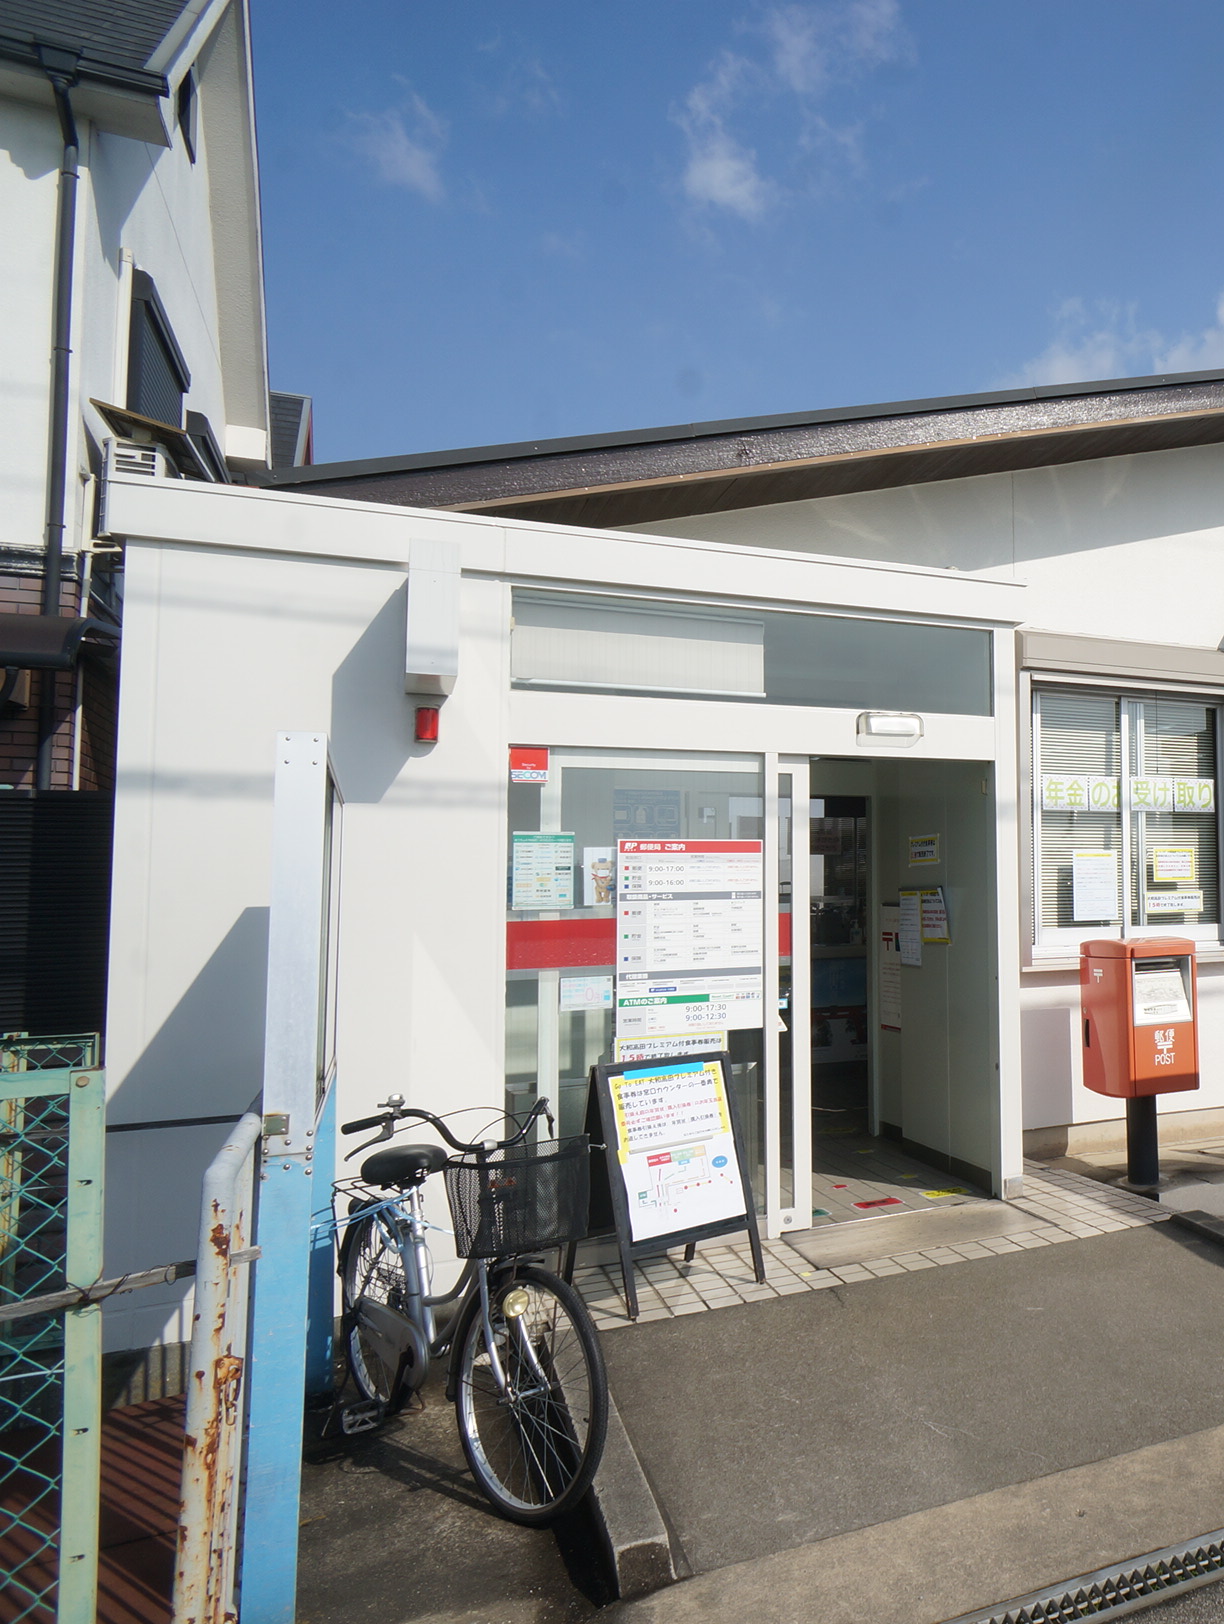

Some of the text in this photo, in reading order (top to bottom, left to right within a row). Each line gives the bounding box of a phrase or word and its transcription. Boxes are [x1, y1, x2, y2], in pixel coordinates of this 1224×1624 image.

[511, 770, 547, 779] SECOM
[685, 1003, 727, 1013] 9:00-17:30
[685, 1012, 727, 1022] 9:00-12:30
[1154, 1028, 1176, 1044] 郵便
[1154, 1052, 1176, 1066] POST
